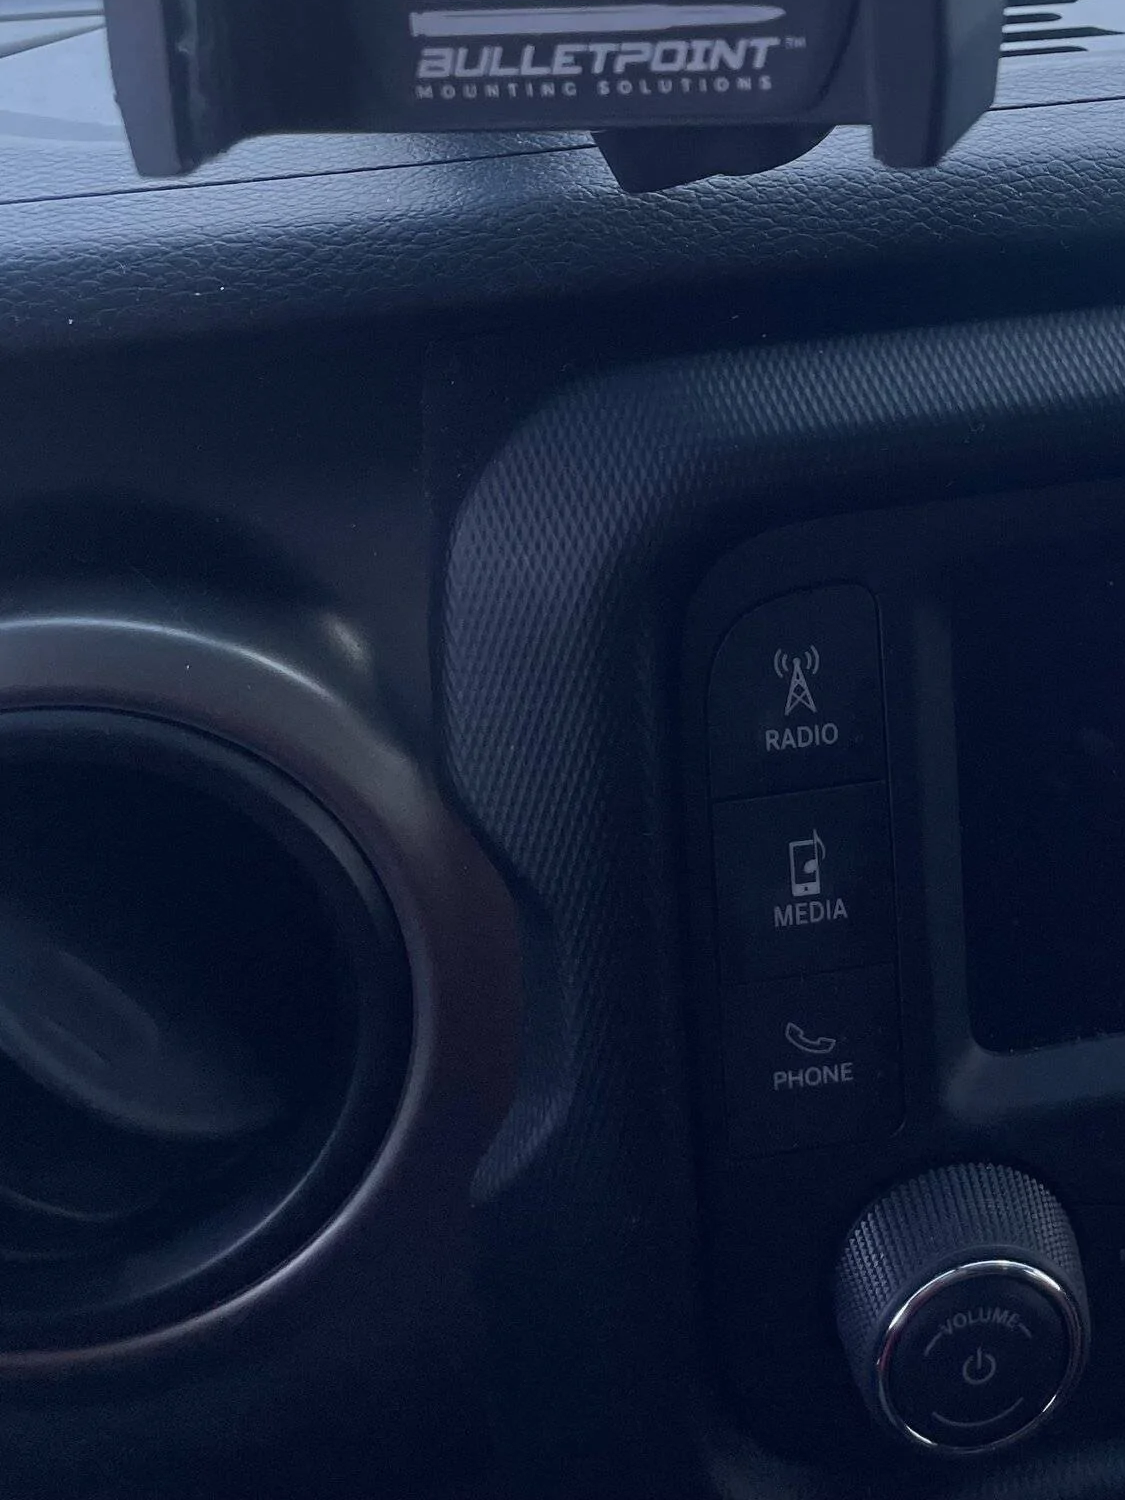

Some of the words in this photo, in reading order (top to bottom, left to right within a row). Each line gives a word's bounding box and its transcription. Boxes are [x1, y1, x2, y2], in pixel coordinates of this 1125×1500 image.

[415, 82, 577, 100] MOUNTING
[599, 75, 773, 96] SOLUTIONS
[765, 722, 839, 751] RADIO
[773, 898, 847, 927] MEDIA
[773, 1062, 853, 1091] PHONE
[942, 1306, 1021, 1336] VOLUME
